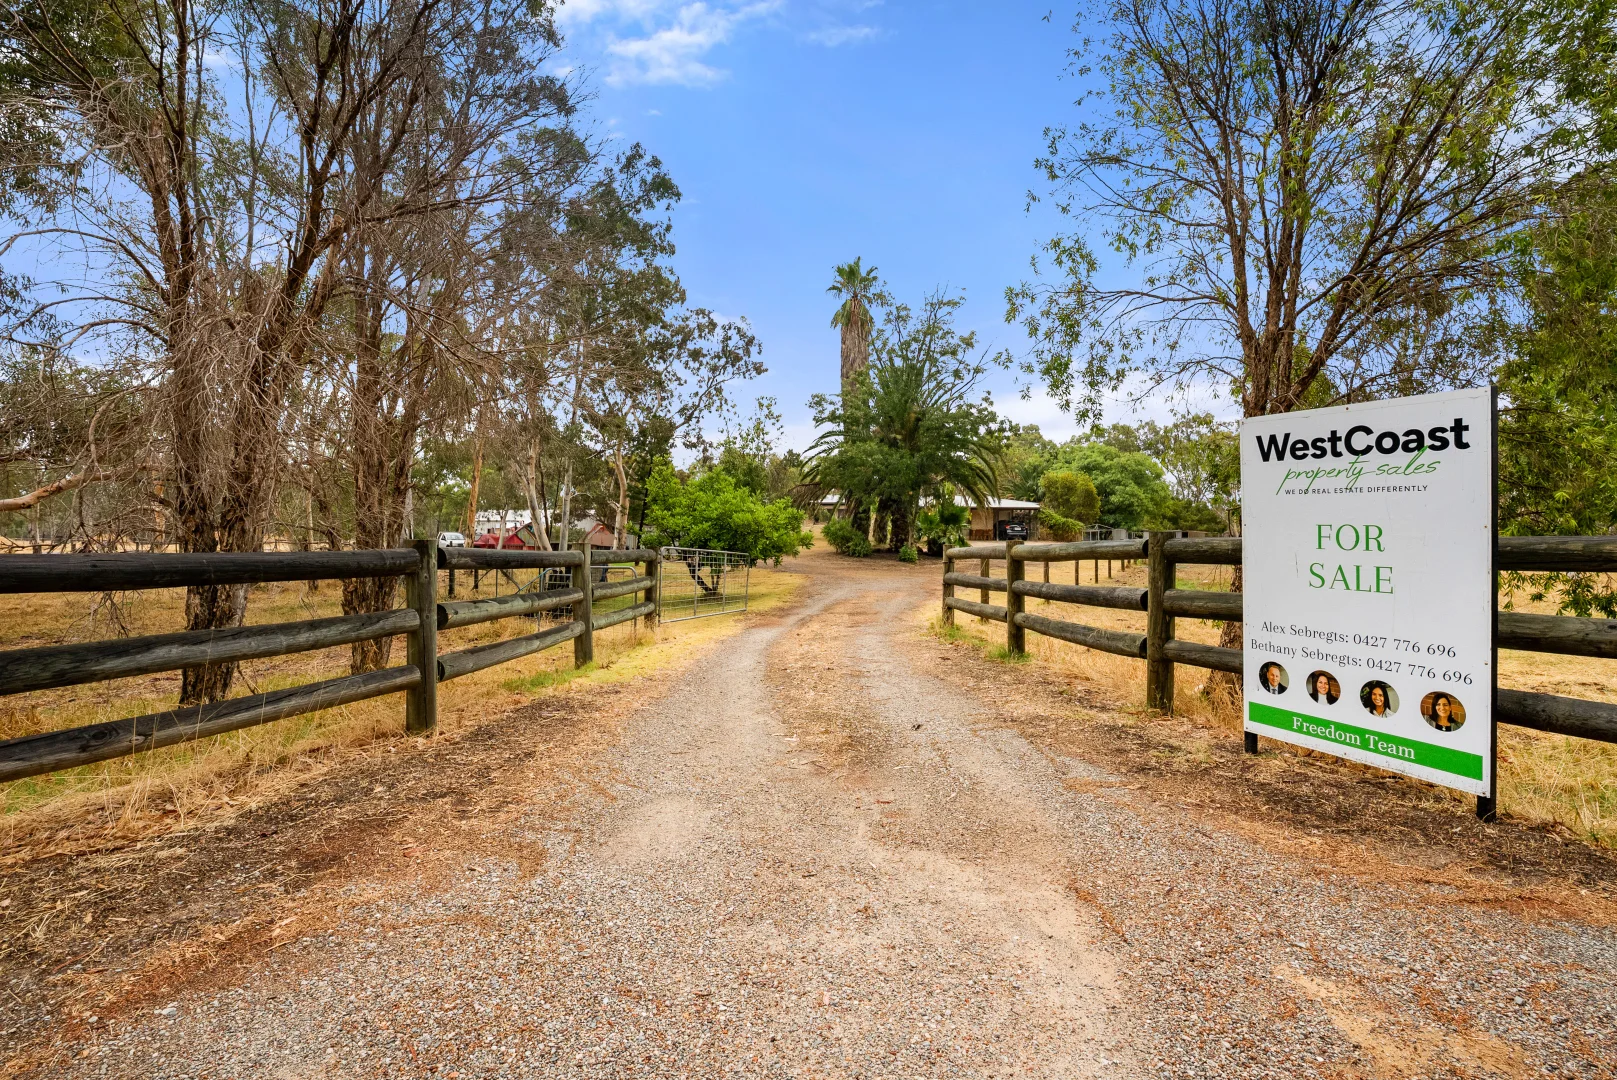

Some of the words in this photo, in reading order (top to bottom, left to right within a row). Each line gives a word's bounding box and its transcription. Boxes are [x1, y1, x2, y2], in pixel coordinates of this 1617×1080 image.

[1256, 417, 1471, 462] WestCoast
[1276, 454, 1368, 495] property
[1376, 445, 1441, 476] sales
[1334, 486, 1364, 494] ESTATE
[1367, 485, 1428, 493] DIFFERENTLY
[1315, 523, 1386, 552] FOR
[1308, 562, 1394, 594] SALE
[1261, 621, 1286, 634] Alex
[1290, 624, 1349, 644] Sebregts:
[1353, 633, 1387, 649] 0427
[1393, 638, 1421, 653] 776
[1427, 643, 1456, 658] 696
[1251, 639, 1297, 659] Bethany
[1301, 647, 1362, 668] Sebregts:
[1367, 657, 1402, 673] 0427
[1408, 663, 1436, 679] 776
[1443, 670, 1473, 685] 696
[1292, 716, 1361, 746] Freedom
[1366, 734, 1416, 760] Team
